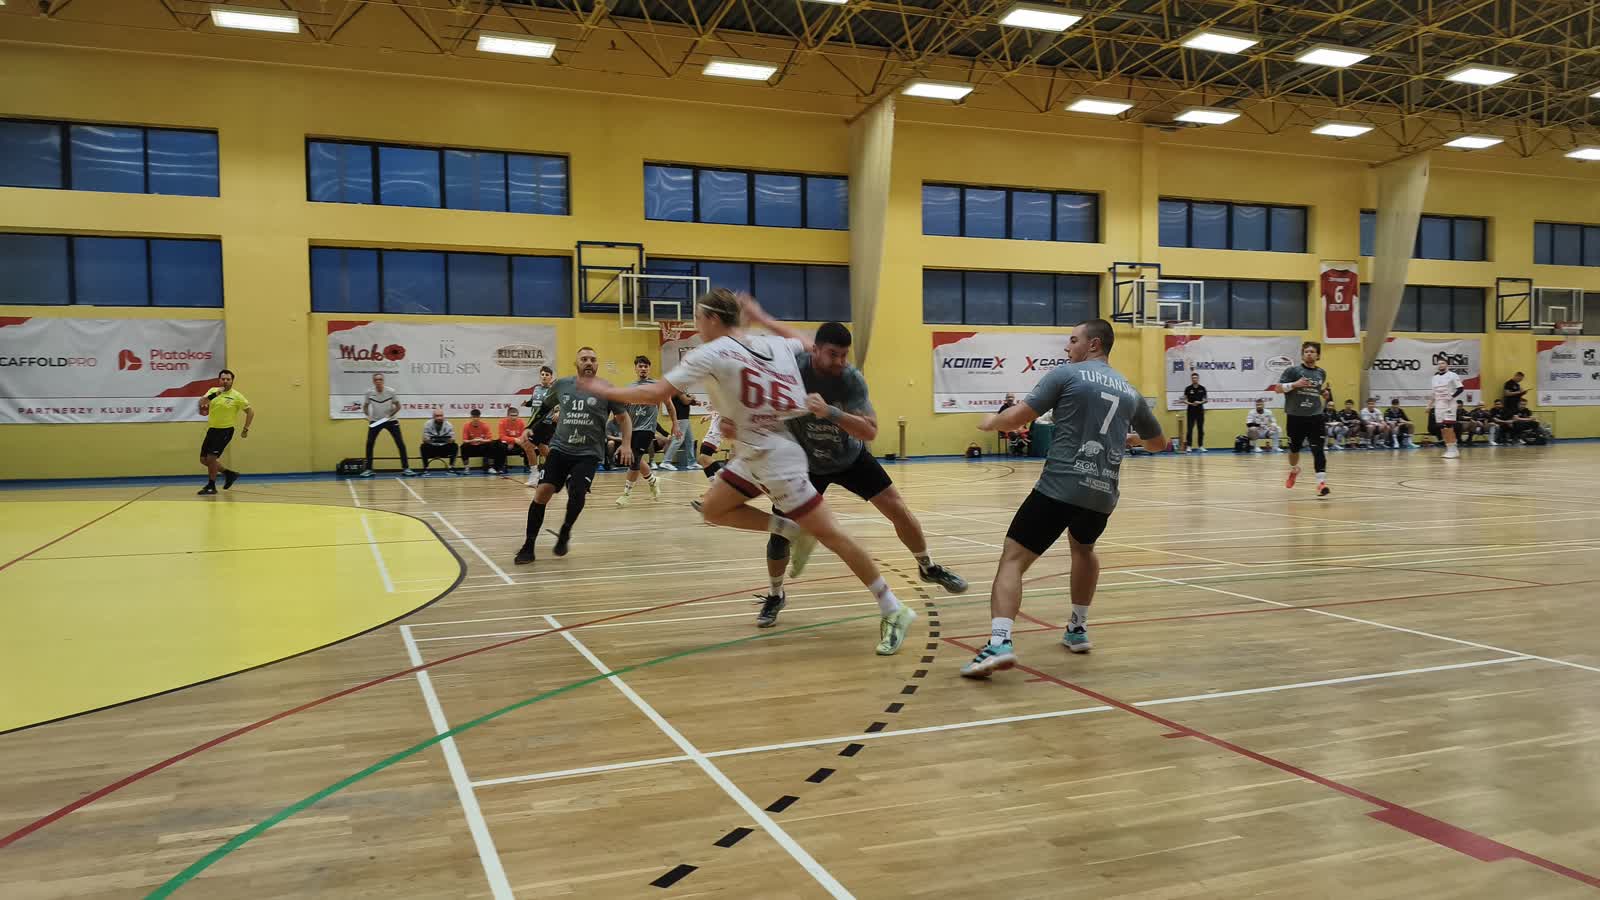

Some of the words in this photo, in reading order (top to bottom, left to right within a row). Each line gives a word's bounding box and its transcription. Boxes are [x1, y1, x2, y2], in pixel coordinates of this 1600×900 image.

[1335, 285, 1344, 304] 6
[497, 349, 543, 359] KUCHNIA
[150, 361, 190, 370] team
[411, 362, 455, 374] HOTEL
[456, 362, 481, 374] SEN
[942, 356, 1007, 370] KOIMEX
[1373, 359, 1421, 371] RECARO
[741, 367, 798, 411] 66
[17, 406, 94, 415] PARTNERZY
[101, 406, 142, 414] KLUBU
[572, 399, 584, 410] 10
[1100, 391, 1120, 434] 7
